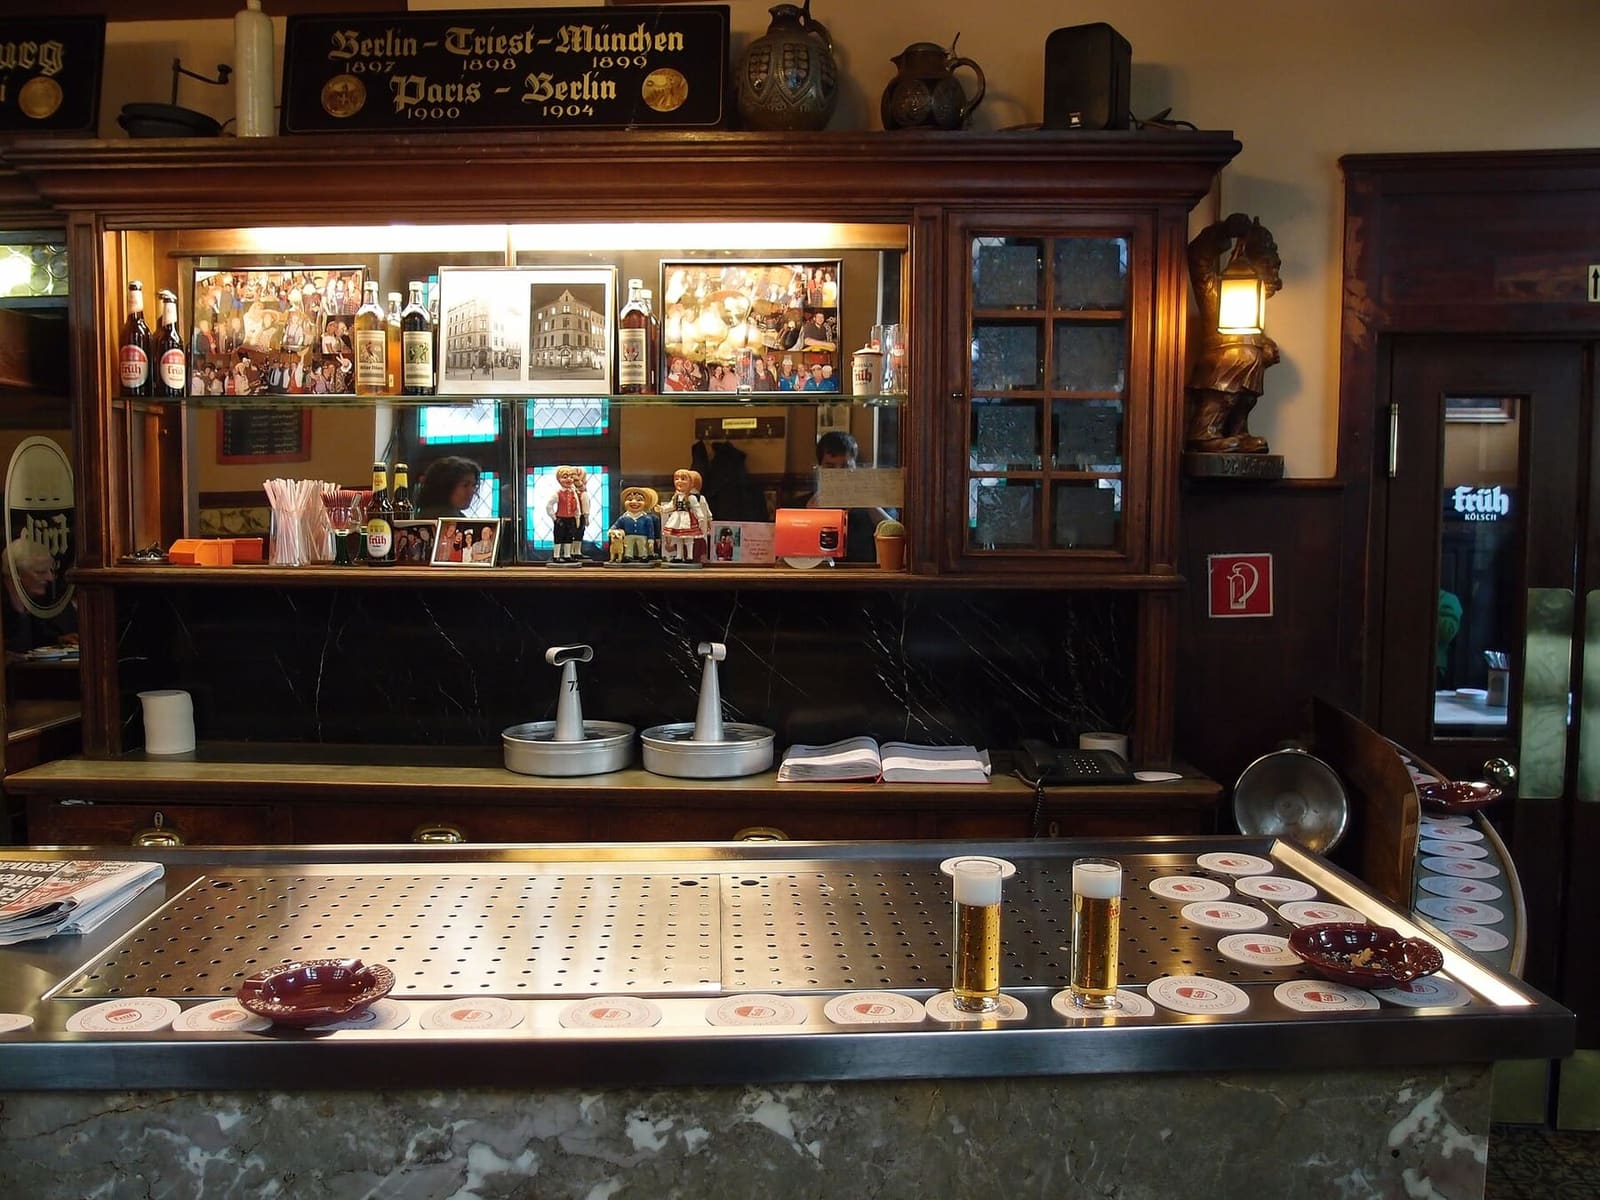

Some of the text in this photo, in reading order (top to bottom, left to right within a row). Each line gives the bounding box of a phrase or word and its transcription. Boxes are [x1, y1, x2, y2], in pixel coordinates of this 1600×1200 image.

[328, 28, 418, 60] Berlin
[444, 25, 535, 56] Triest
[555, 22, 684, 55] München
[346, 61, 396, 73] 1897
[463, 58, 517, 71] 1898
[592, 55, 648, 69] 1899
[389, 75, 481, 112] Paris
[521, 70, 617, 103] Berlin
[407, 107, 460, 120] 1900
[543, 104, 594, 118] 1904
